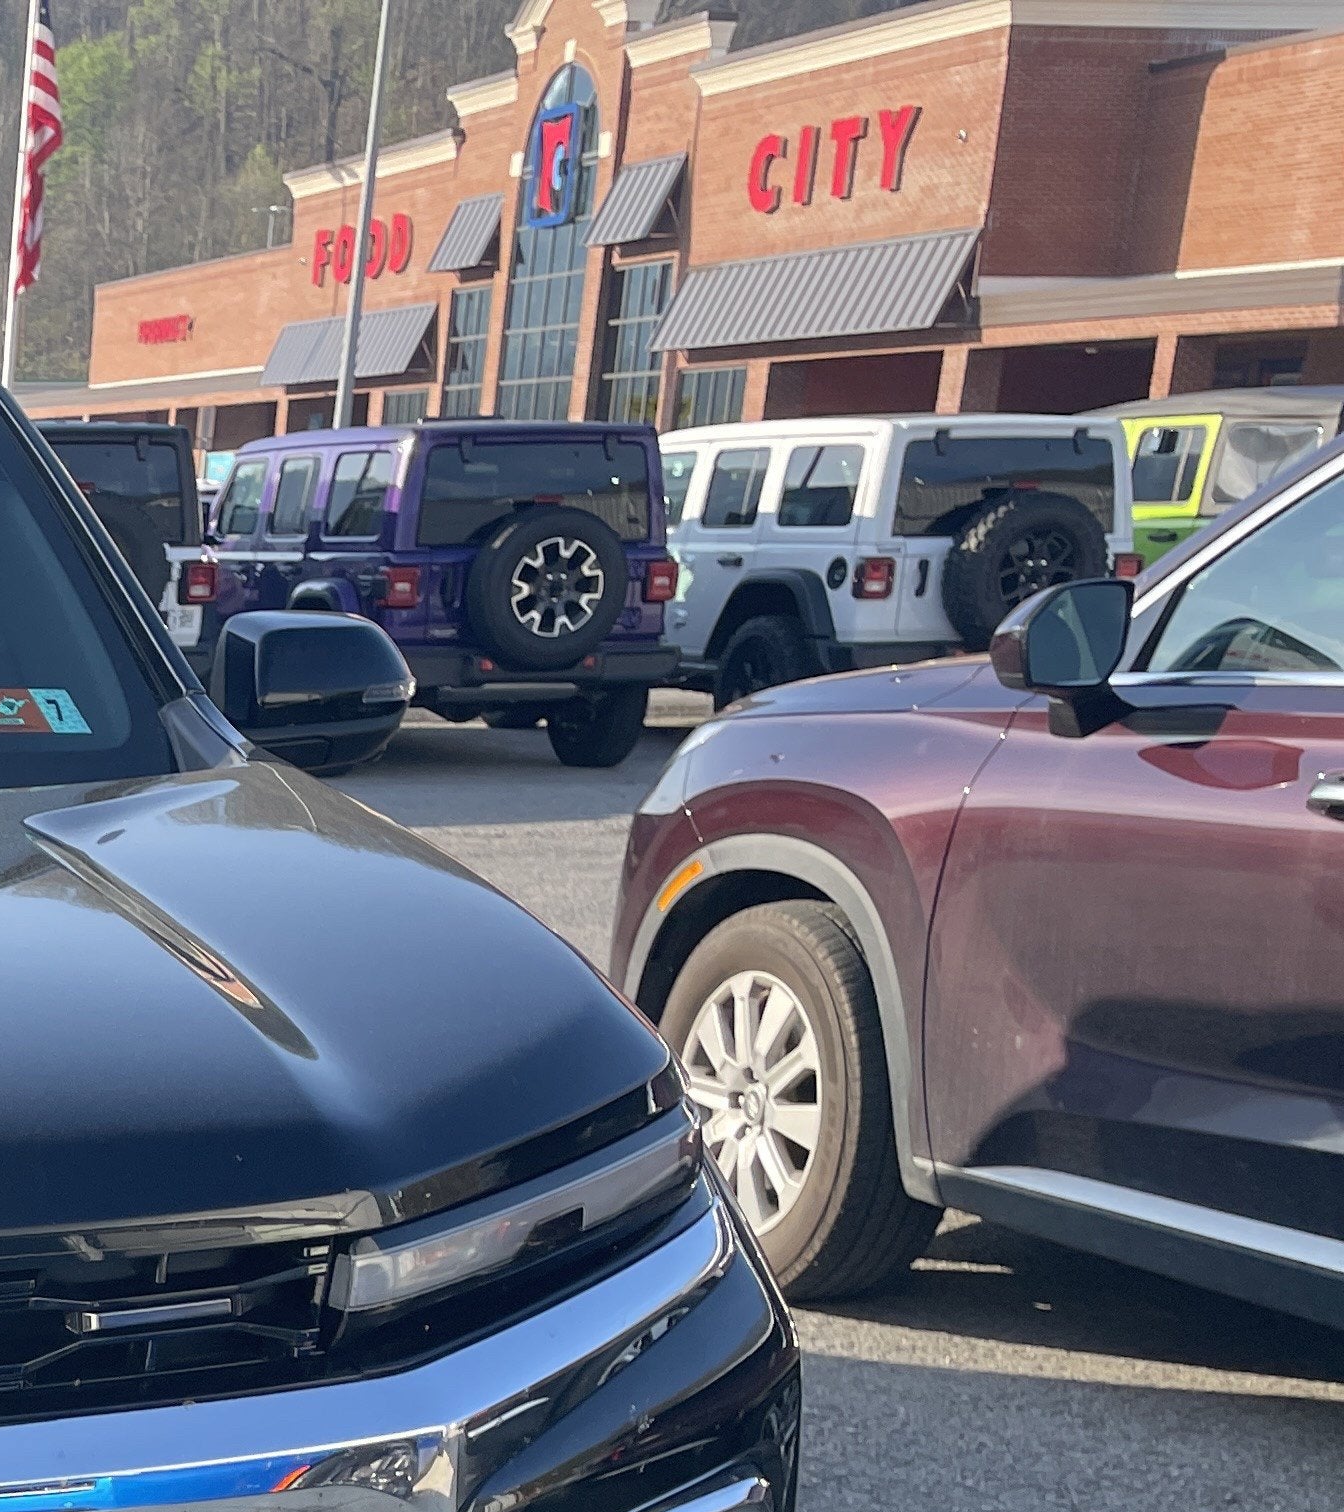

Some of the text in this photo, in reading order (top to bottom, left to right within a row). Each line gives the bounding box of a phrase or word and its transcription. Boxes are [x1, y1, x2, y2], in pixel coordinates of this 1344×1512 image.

[748, 105, 922, 214] CITY
[312, 212, 413, 287] FOOD
[43, 697, 64, 721] 7
